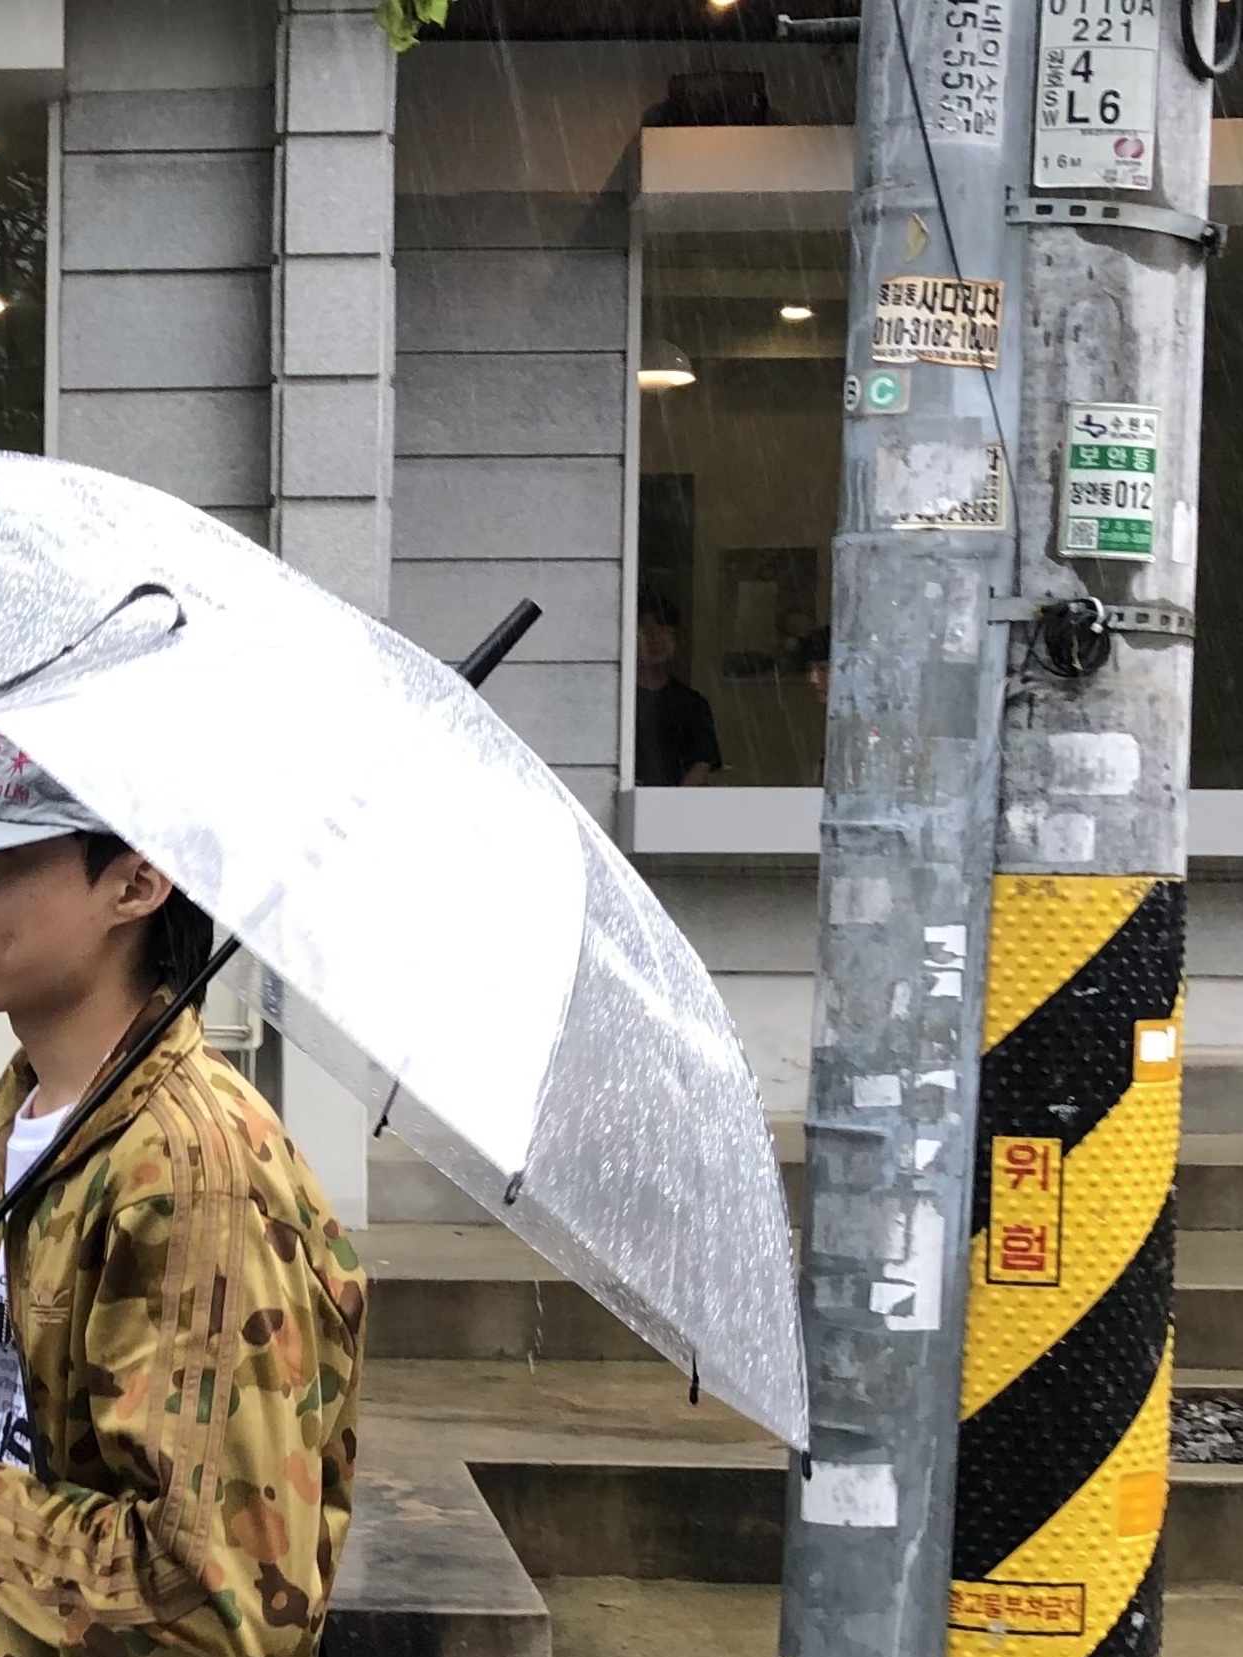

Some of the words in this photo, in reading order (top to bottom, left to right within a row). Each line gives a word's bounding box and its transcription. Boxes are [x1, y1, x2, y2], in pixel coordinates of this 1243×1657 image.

[1072, 17, 1132, 42] 221
[1070, 50, 1095, 84] 4
[1003, 1143, 1051, 1272] 위험
